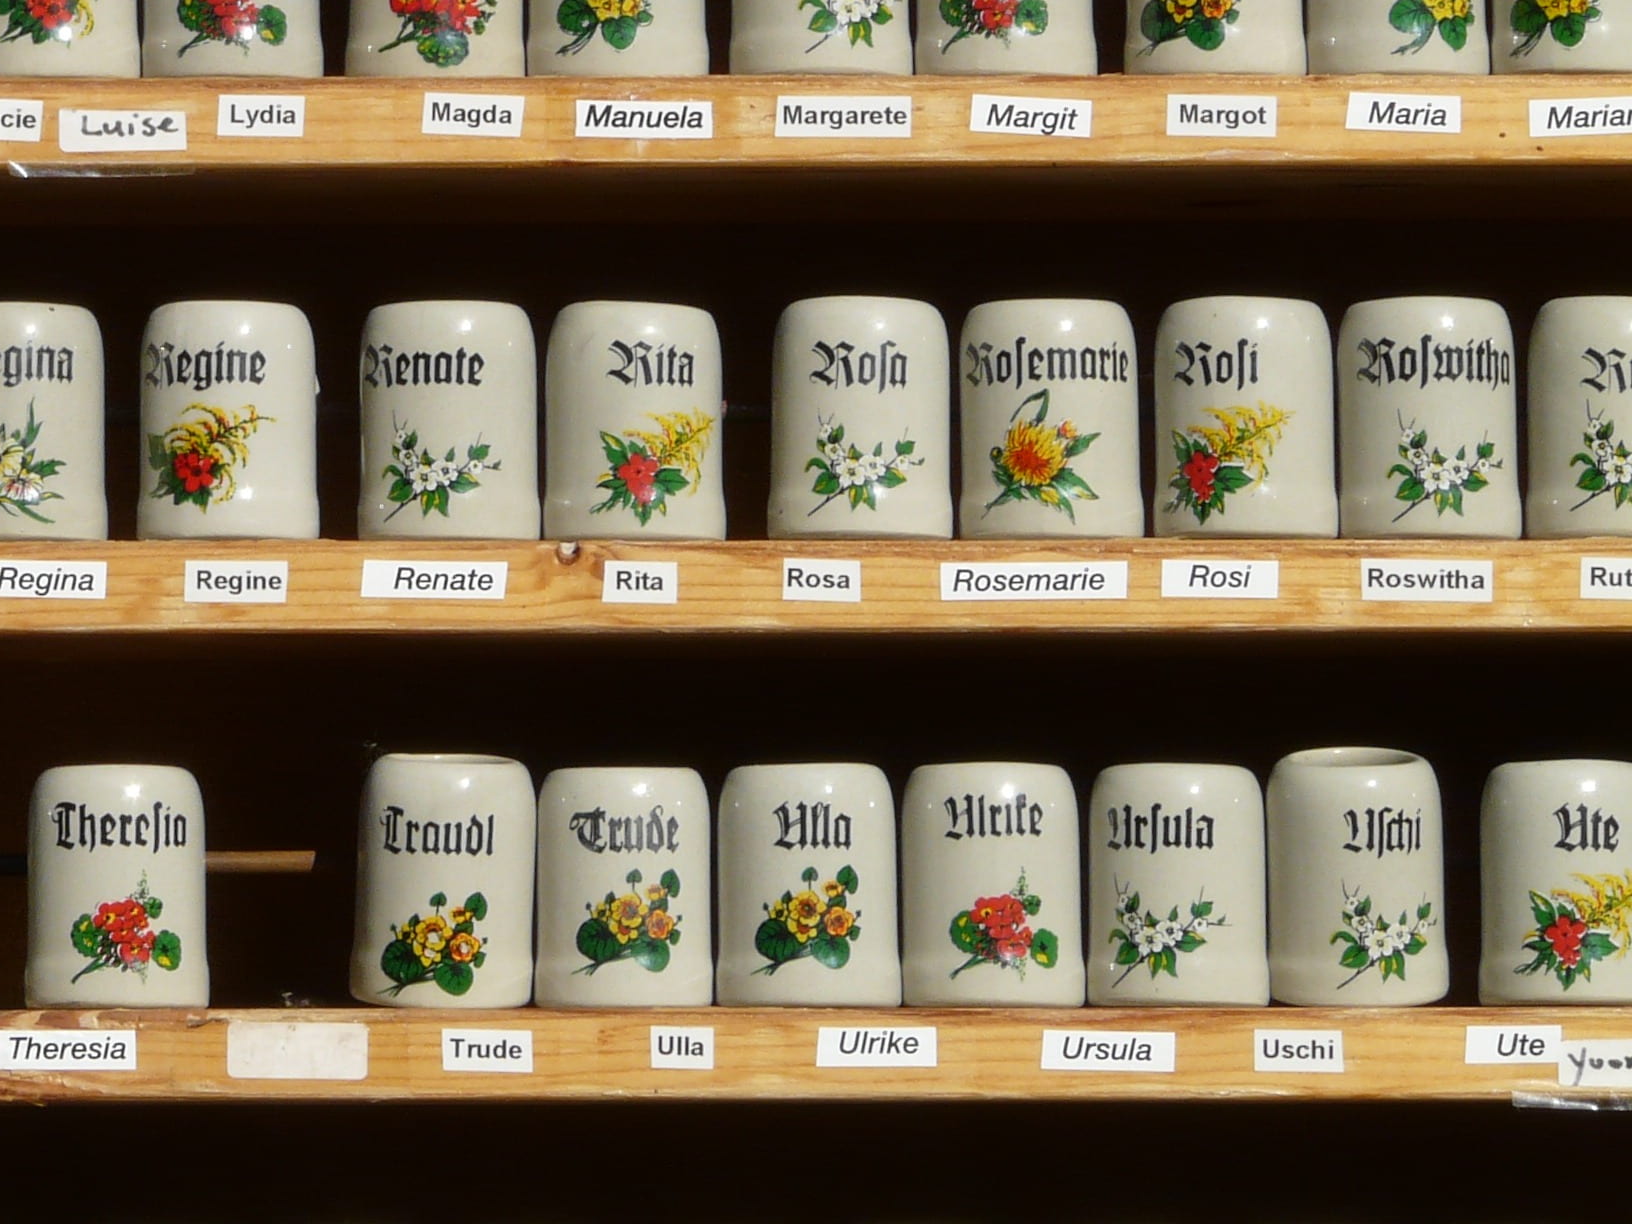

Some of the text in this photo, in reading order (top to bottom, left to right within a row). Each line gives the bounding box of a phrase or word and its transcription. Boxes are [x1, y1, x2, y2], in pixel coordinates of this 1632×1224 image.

[81, 113, 179, 138] Luise
[230, 104, 296, 129] Lydia
[431, 102, 512, 128] Magda
[584, 104, 703, 129] Manuela
[783, 105, 907, 130] Margarete
[986, 103, 1078, 137] Margit
[1180, 103, 1266, 129] Margot
[1368, 101, 1447, 126] Maria
[145, 341, 266, 392] Regine
[362, 343, 485, 389] Renate
[606, 339, 694, 387] Rita
[197, 570, 282, 595] Regine
[394, 567, 494, 591] Renate
[616, 570, 663, 591] Rita
[787, 567, 850, 589] Rosa
[953, 569, 1105, 592] Rosemarie
[1189, 564, 1250, 588] Rosi
[1368, 568, 1485, 589] Roswitha
[379, 805, 494, 857] Traudl
[568, 805, 679, 854] Trude
[9, 1036, 126, 1060] Theresia
[449, 1038, 522, 1060] Trude
[658, 1035, 704, 1057] Ulla
[839, 1031, 919, 1055] Ulrike
[1062, 1036, 1152, 1061] Ursula
[1263, 1039, 1334, 1060] Uschi
[1497, 1033, 1545, 1057] Ute
